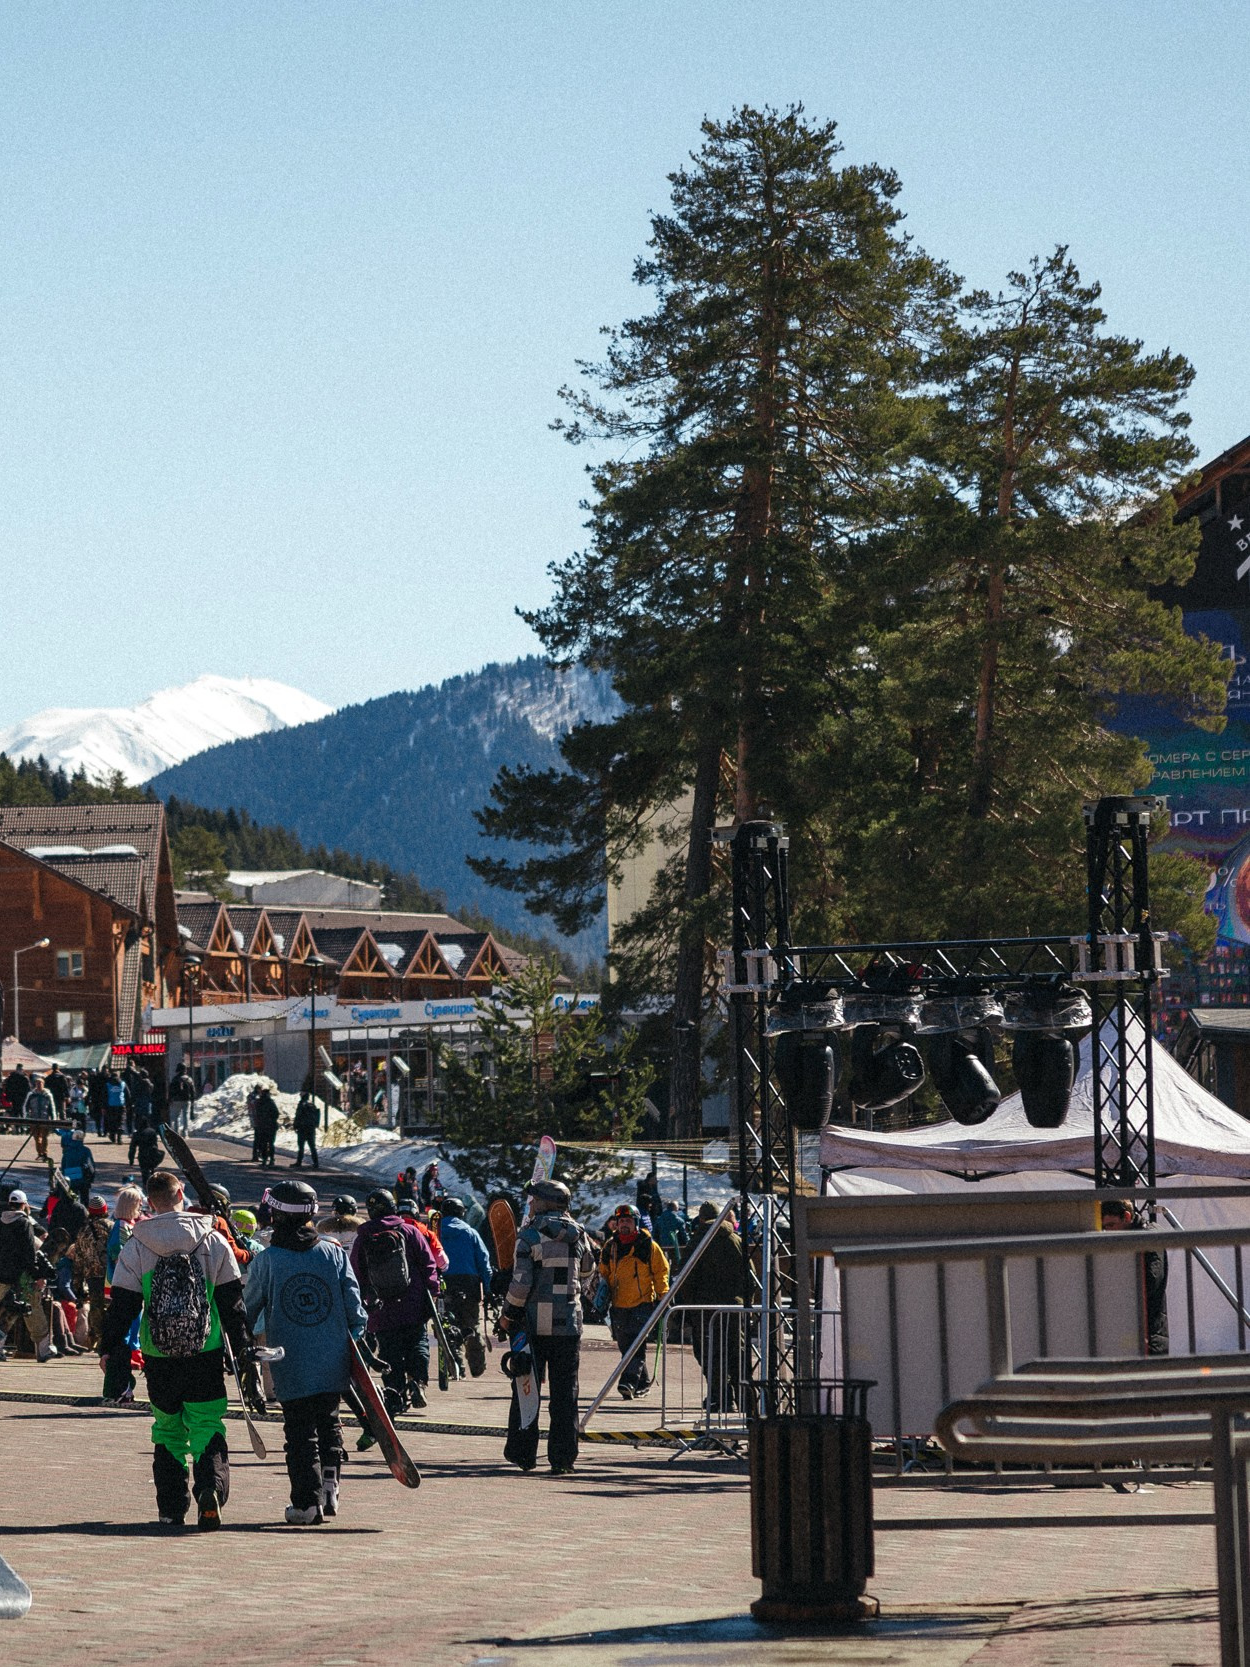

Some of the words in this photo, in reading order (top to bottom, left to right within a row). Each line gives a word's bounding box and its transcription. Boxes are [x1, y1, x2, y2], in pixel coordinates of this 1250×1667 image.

[1205, 751, 1216, 762] С
[1149, 767, 1245, 781] РАВЛЕНИЕМ
[1168, 810, 1211, 827] РТ
